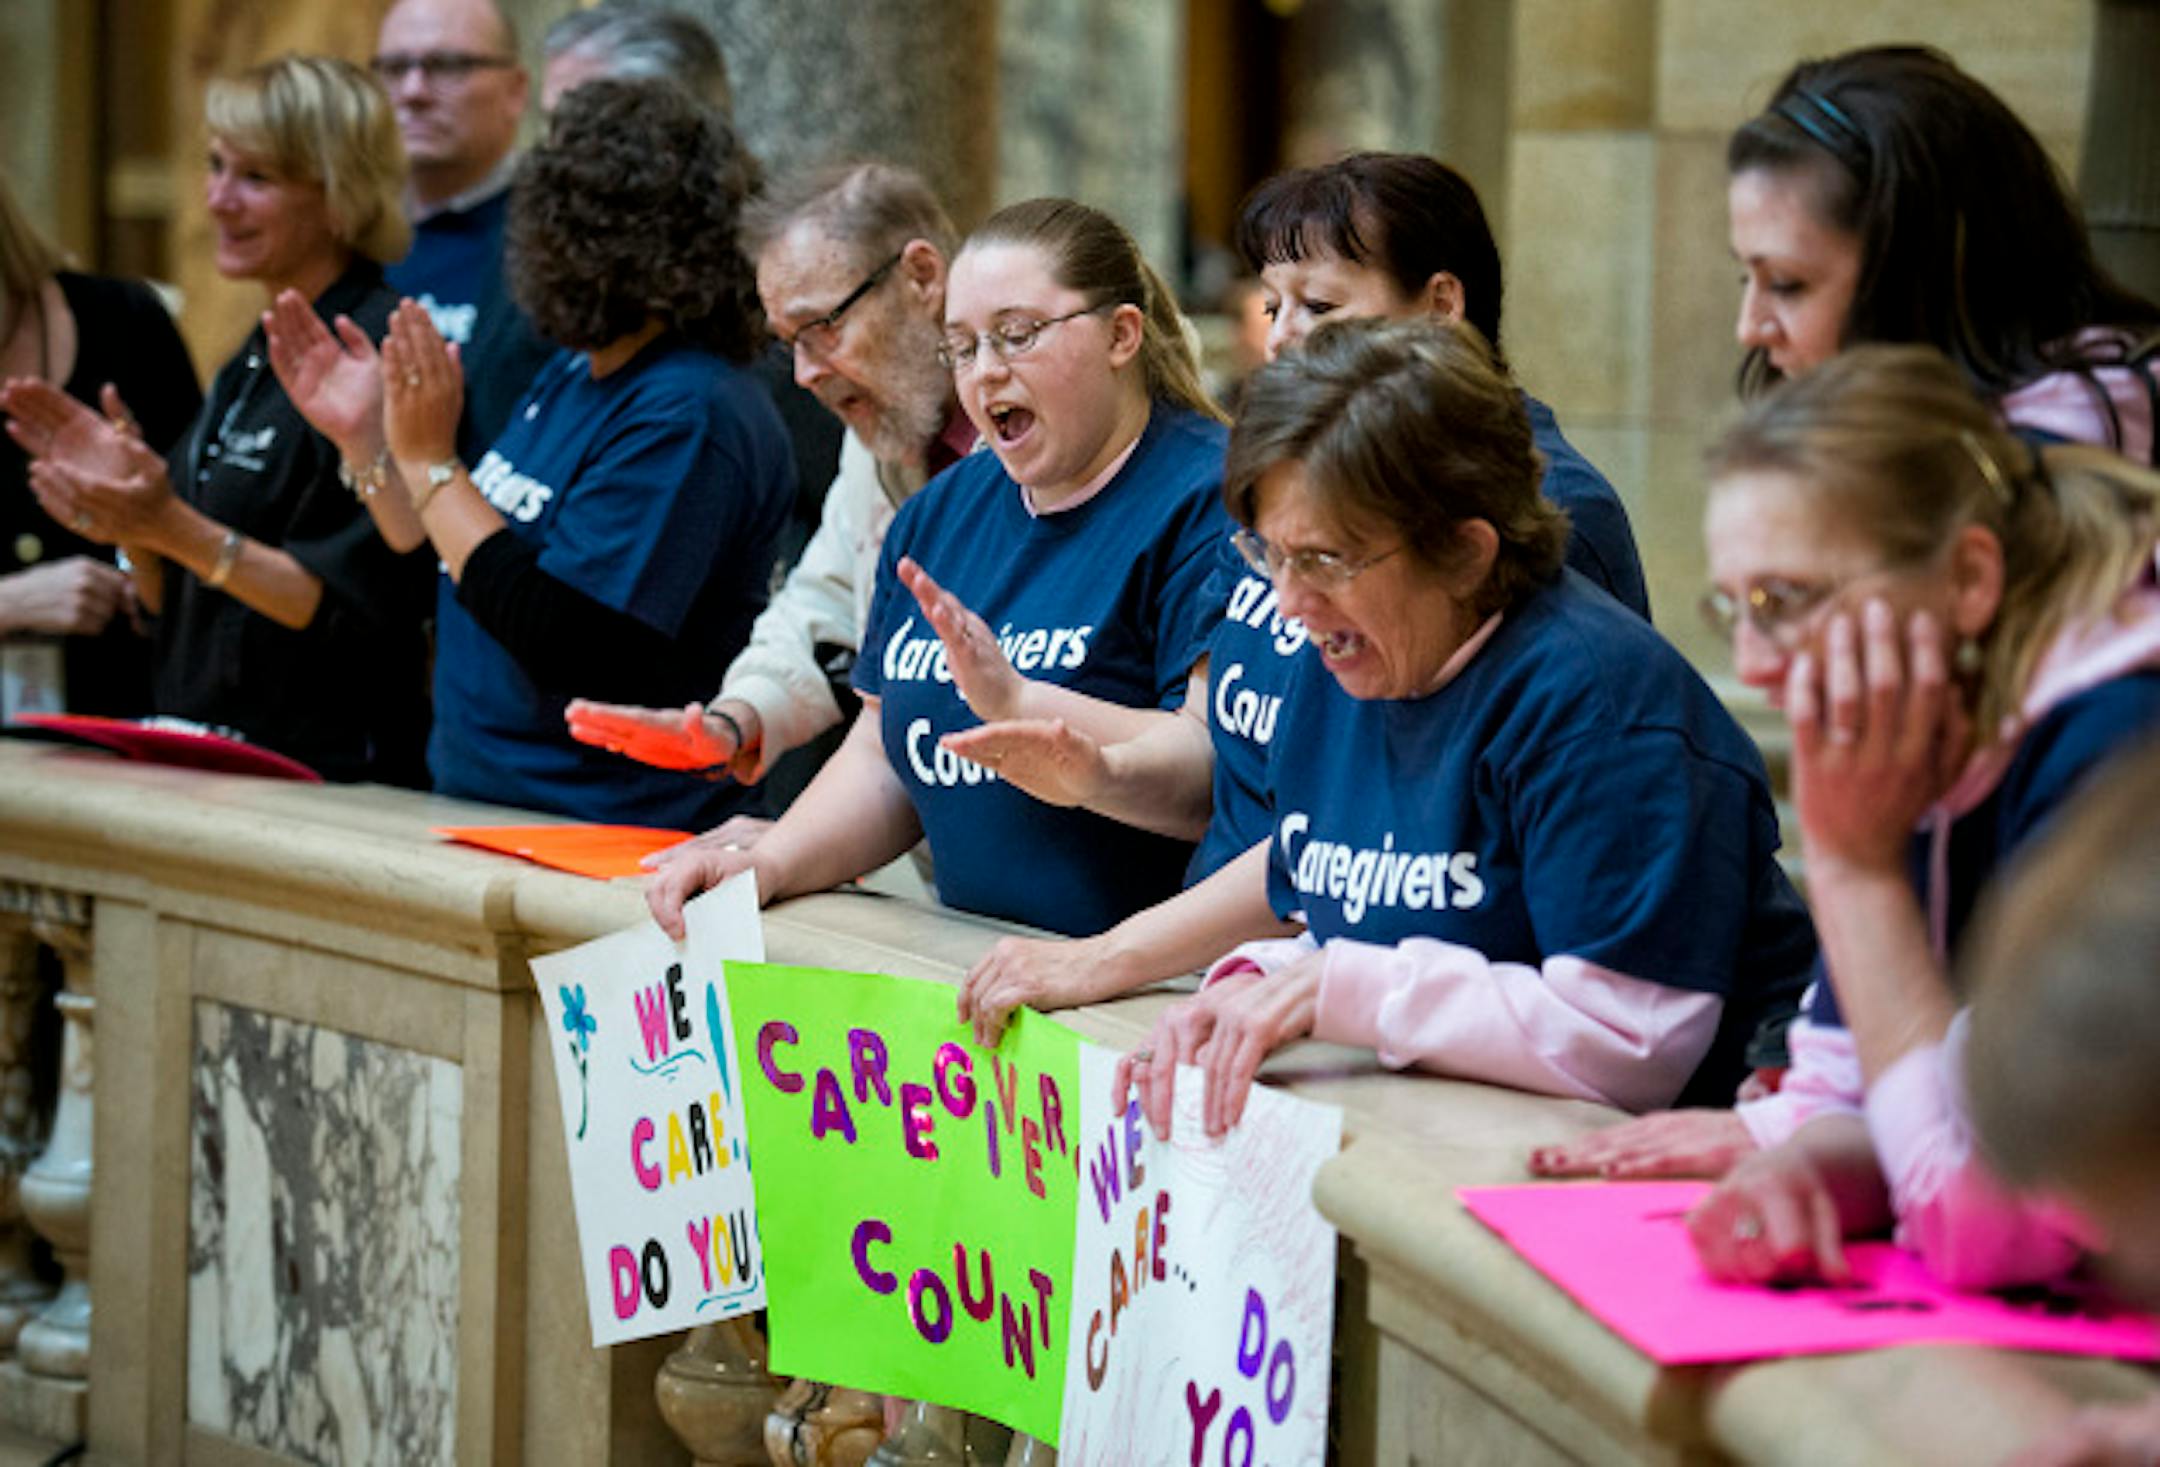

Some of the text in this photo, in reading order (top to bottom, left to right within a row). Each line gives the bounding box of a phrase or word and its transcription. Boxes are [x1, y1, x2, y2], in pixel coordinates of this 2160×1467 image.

[883, 616, 1094, 700] Carevers
[1216, 663, 1283, 744] Cou
[907, 718, 1001, 786] Cou
[1279, 812, 1485, 924] Caregivers
[635, 963, 693, 1062] WE
[757, 1021, 1080, 1200] CAREGIVER
[1090, 1099, 1145, 1223] WE
[608, 1208, 764, 1320] DO YOU
[851, 1220, 1054, 1380] COUNT
[1236, 1286, 1296, 1426] DO
[1185, 1380, 1270, 1467] YO
